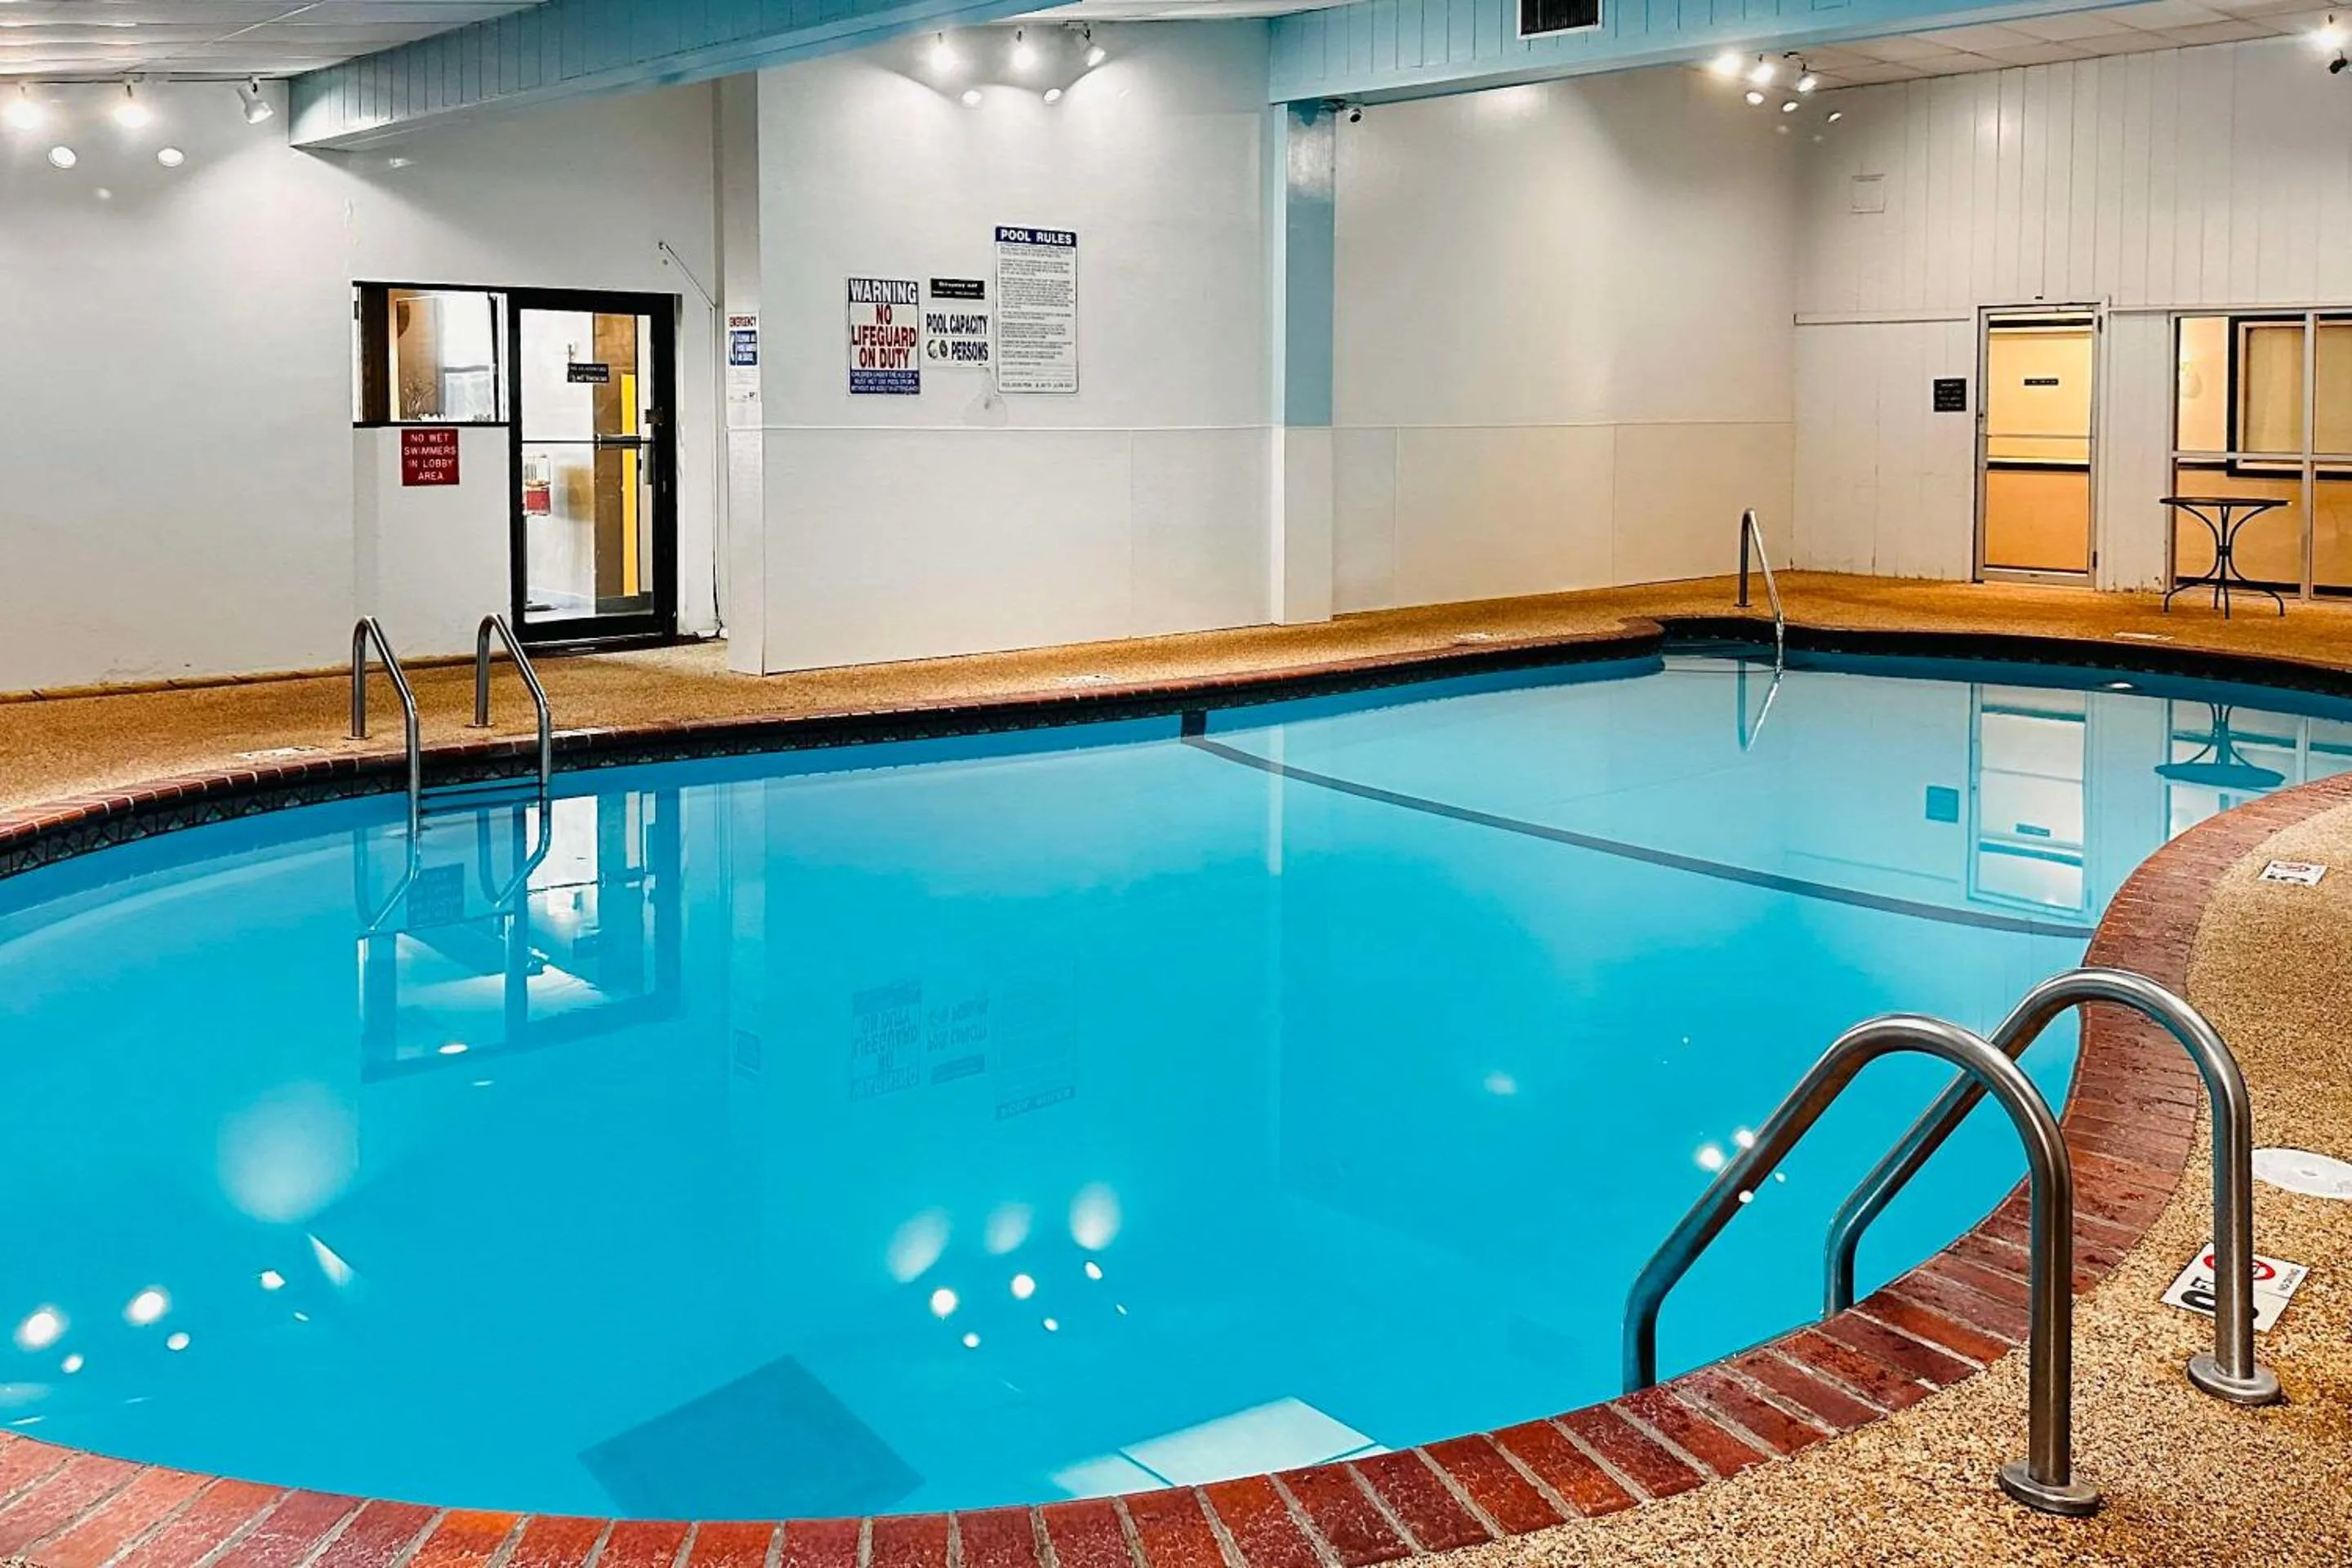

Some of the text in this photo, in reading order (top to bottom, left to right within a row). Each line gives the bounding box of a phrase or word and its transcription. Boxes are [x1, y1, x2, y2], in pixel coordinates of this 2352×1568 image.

[1000, 229, 1072, 245] POOL RULES
[850, 280, 917, 303] WARNING
[875, 304, 893, 325] NO
[926, 314, 947, 334] POOL
[950, 314, 989, 335] CAPACITY
[851, 324, 917, 347] LIFEGUARD
[859, 347, 911, 368] ON DUTY
[951, 341, 989, 361] PERSONS
[410, 433, 449, 443] NO WET
[404, 445, 457, 456] SWIMMERS
[408, 459, 455, 468] IN LOBBY
[418, 471, 445, 481] AREA
